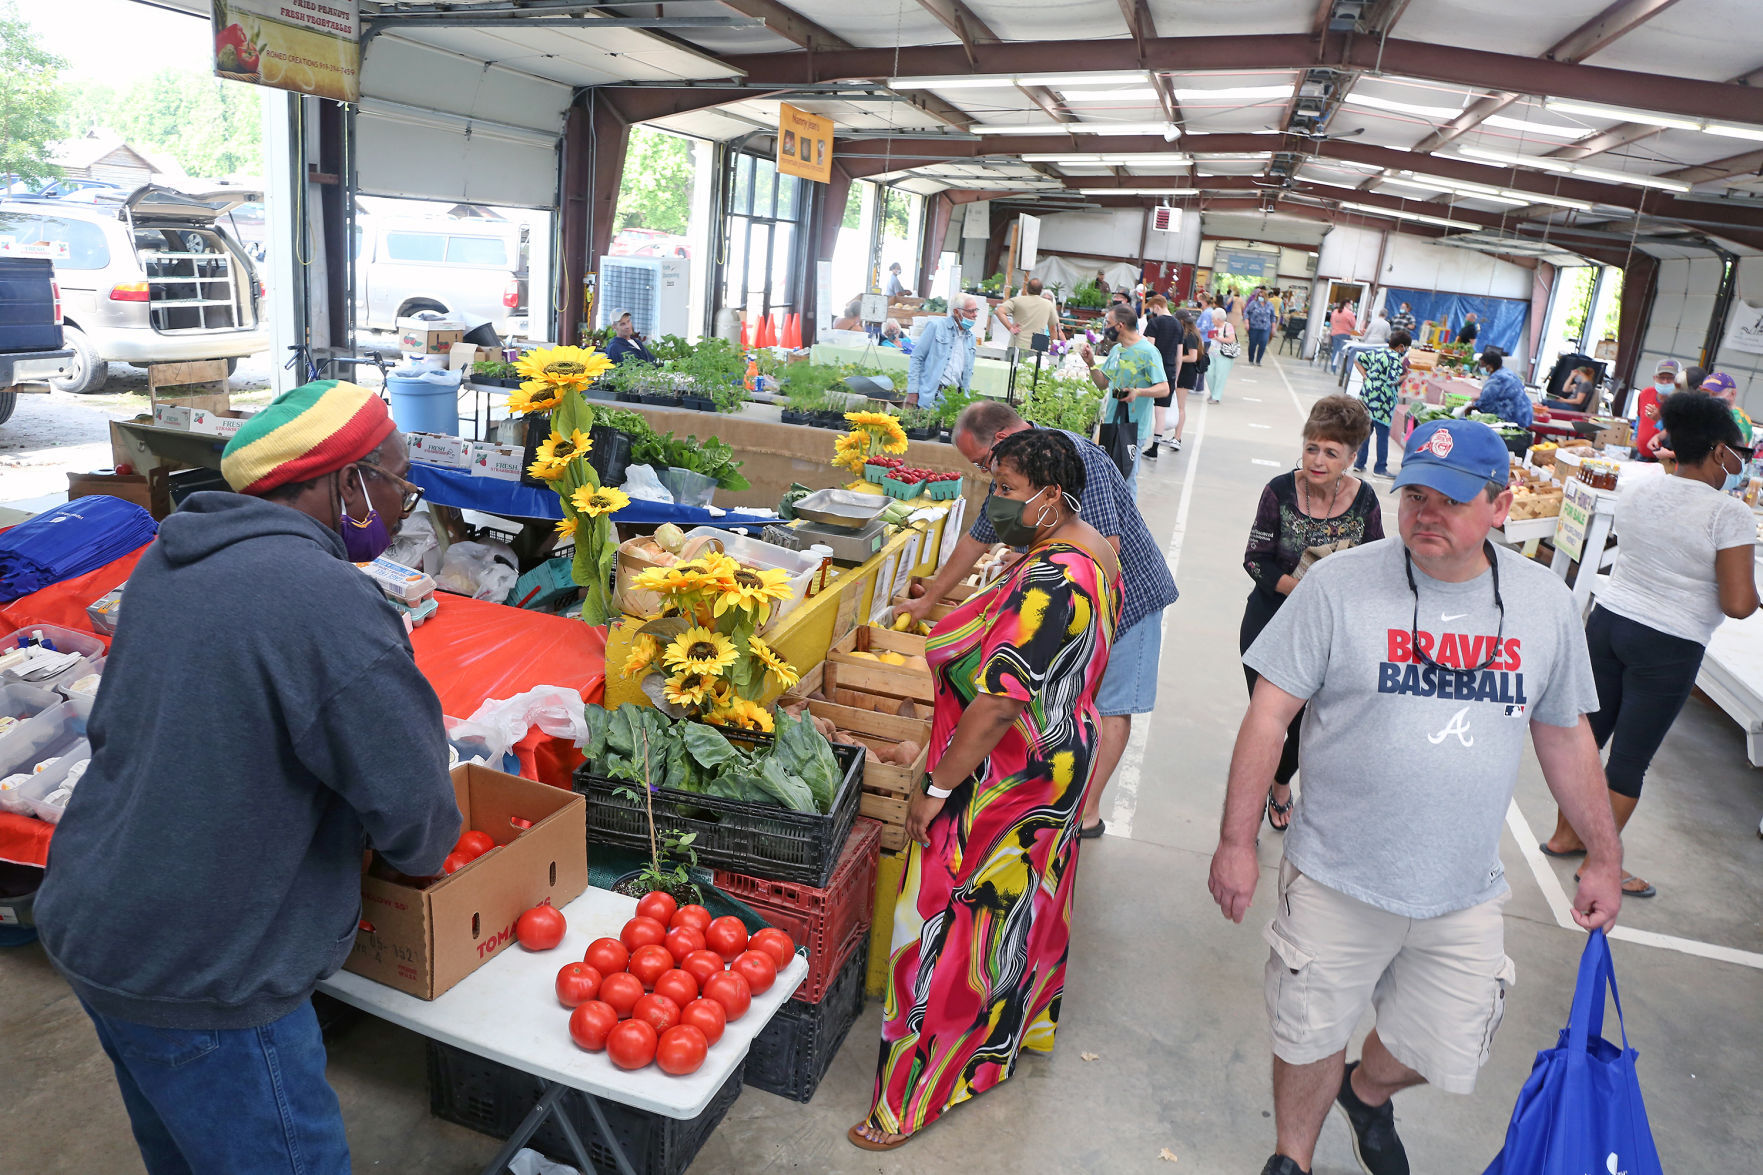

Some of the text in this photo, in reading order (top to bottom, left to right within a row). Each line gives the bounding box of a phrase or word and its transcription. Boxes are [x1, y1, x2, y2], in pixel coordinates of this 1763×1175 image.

[280, 7, 352, 34] FRESH VEGETABLES
[293, 0, 350, 20] FRIED PEANUTS
[428, 444, 446, 452] FRESH
[495, 462, 518, 471] FRESH
[1564, 502, 1586, 526] FOR SALE
[1387, 628, 1522, 672] BRAVES
[1377, 661, 1527, 705] BASEBALL
[1427, 706, 1474, 747] A
